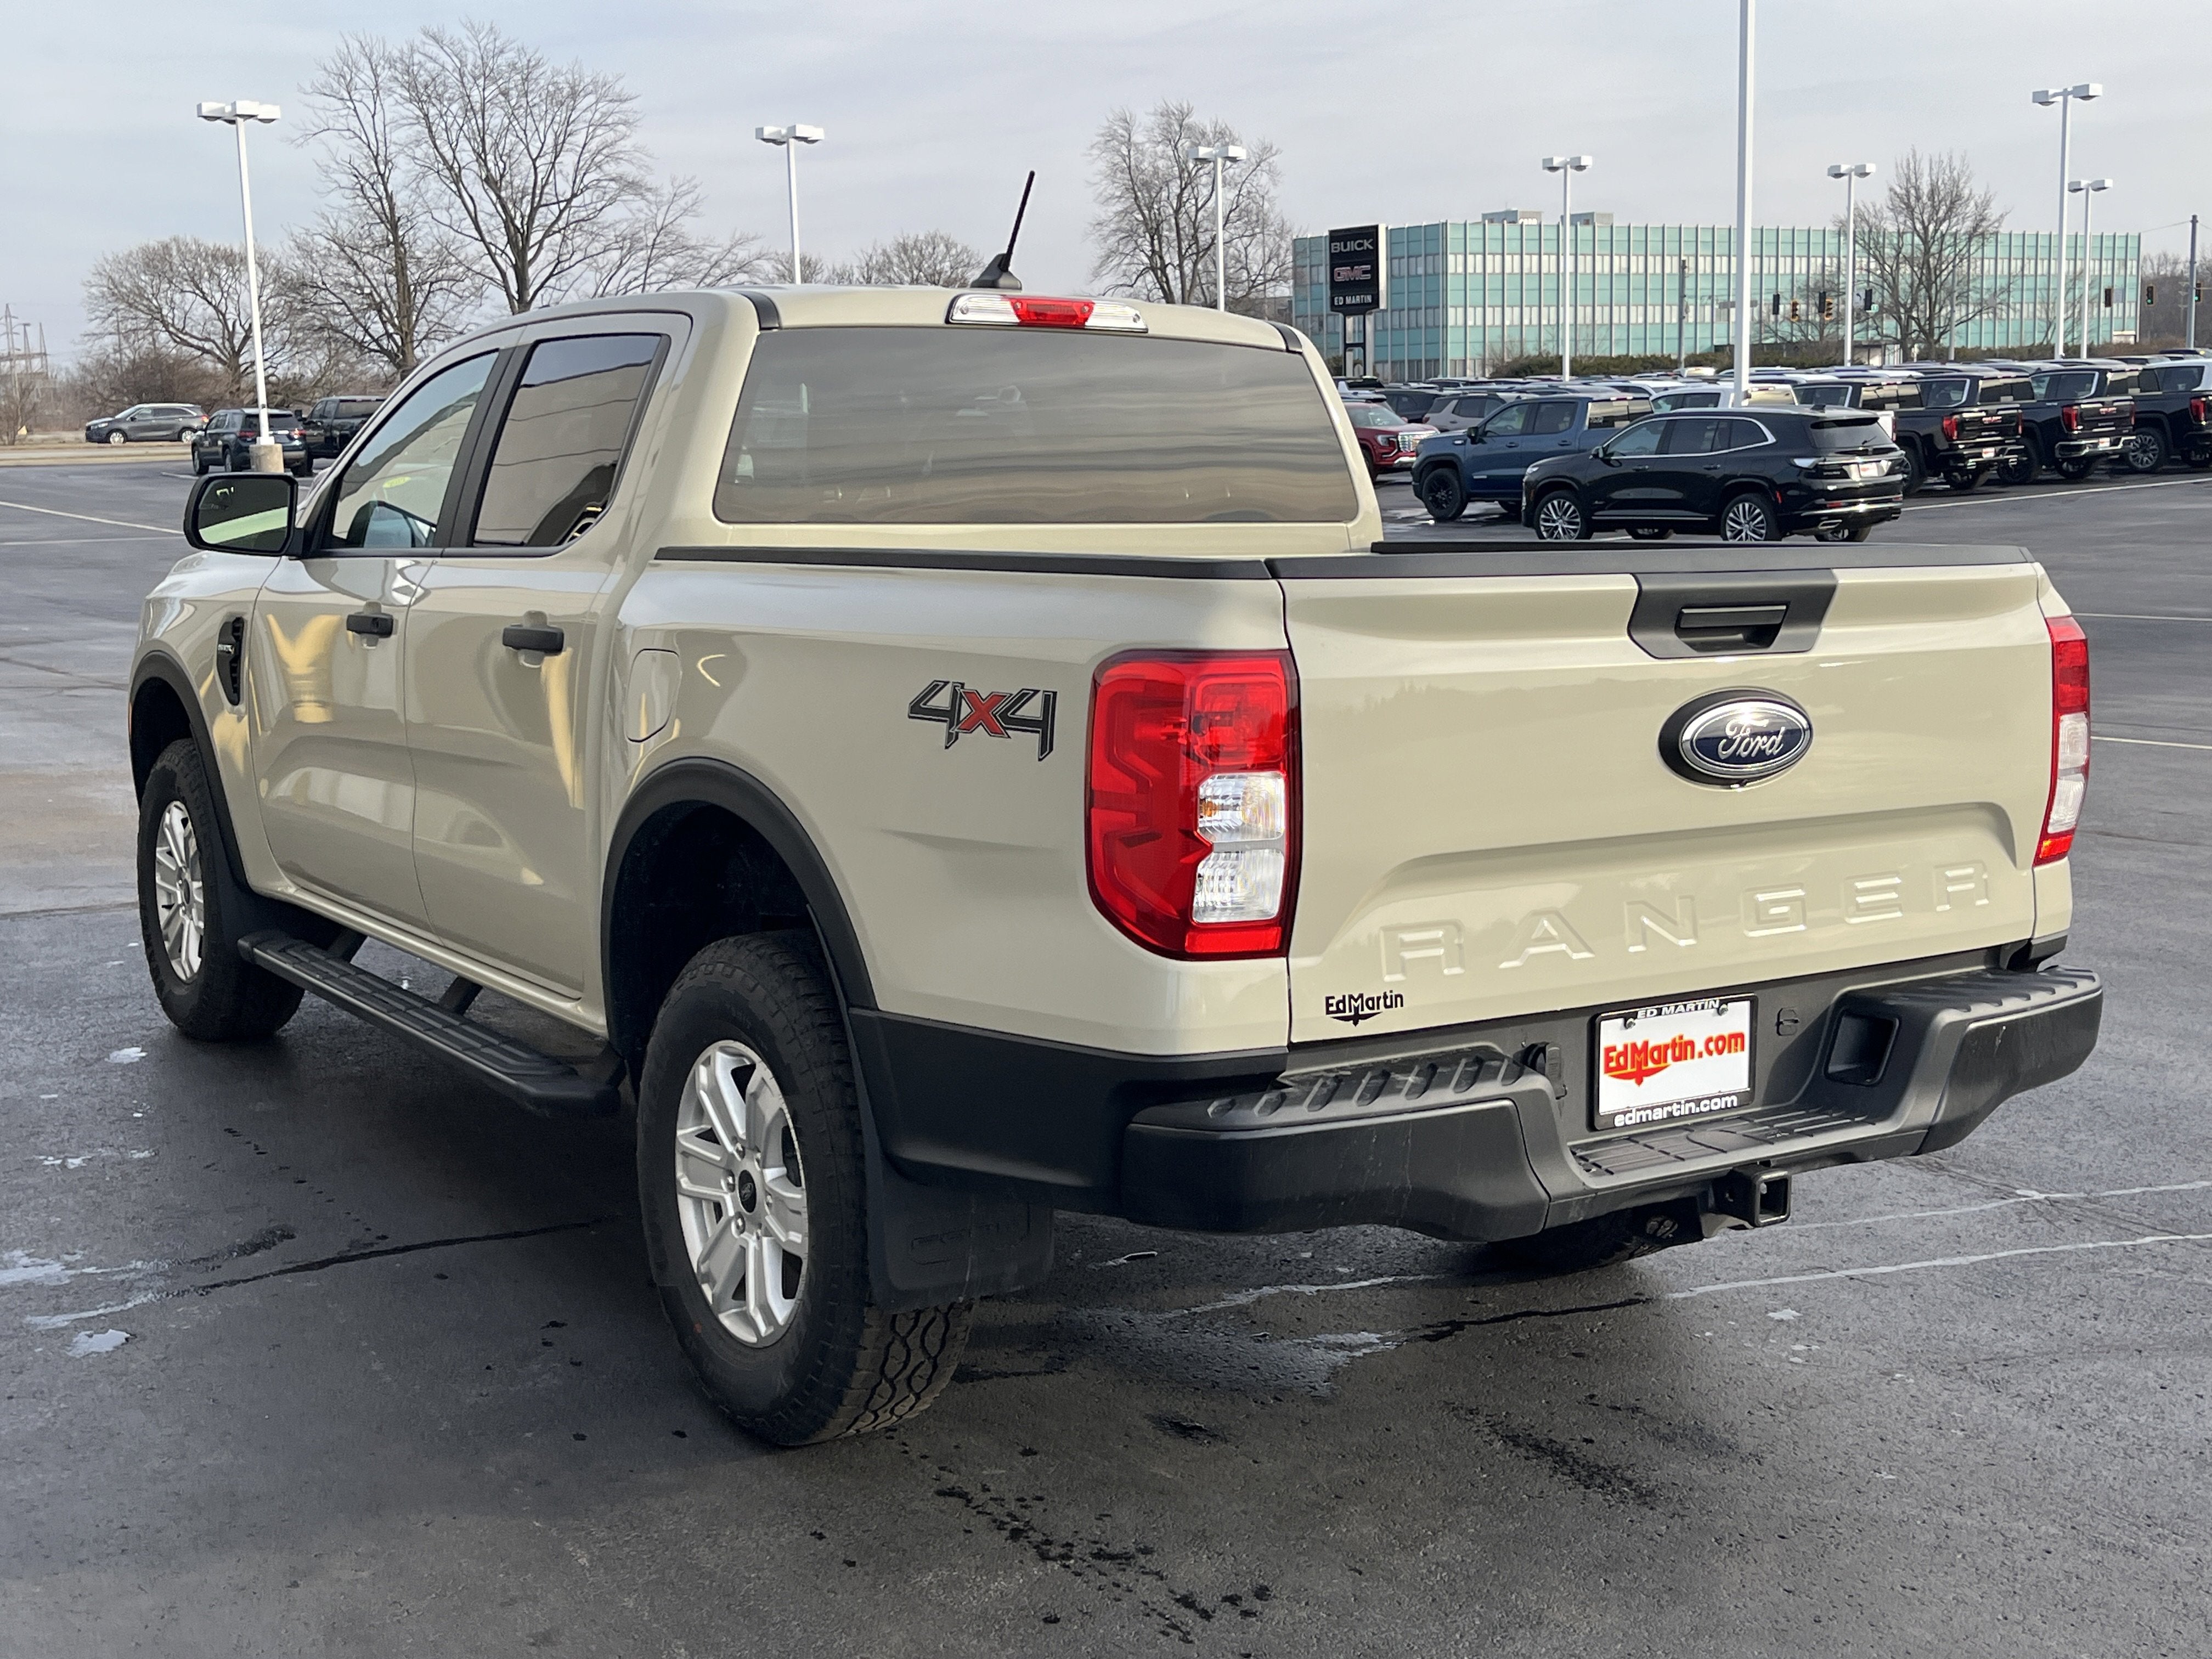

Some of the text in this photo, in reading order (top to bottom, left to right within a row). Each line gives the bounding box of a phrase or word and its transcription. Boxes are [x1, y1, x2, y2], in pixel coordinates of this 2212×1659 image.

[1330, 238, 1373, 253] BUICK
[1334, 265, 1371, 281] GMC
[1334, 295, 1372, 306] ED MARTIN
[1718, 719, 1786, 759] Ford
[1380, 860, 1989, 982] RANGER
[1637, 999, 1719, 1019] ED MARTIN
[1614, 1095, 1737, 1127] edmartin.com
